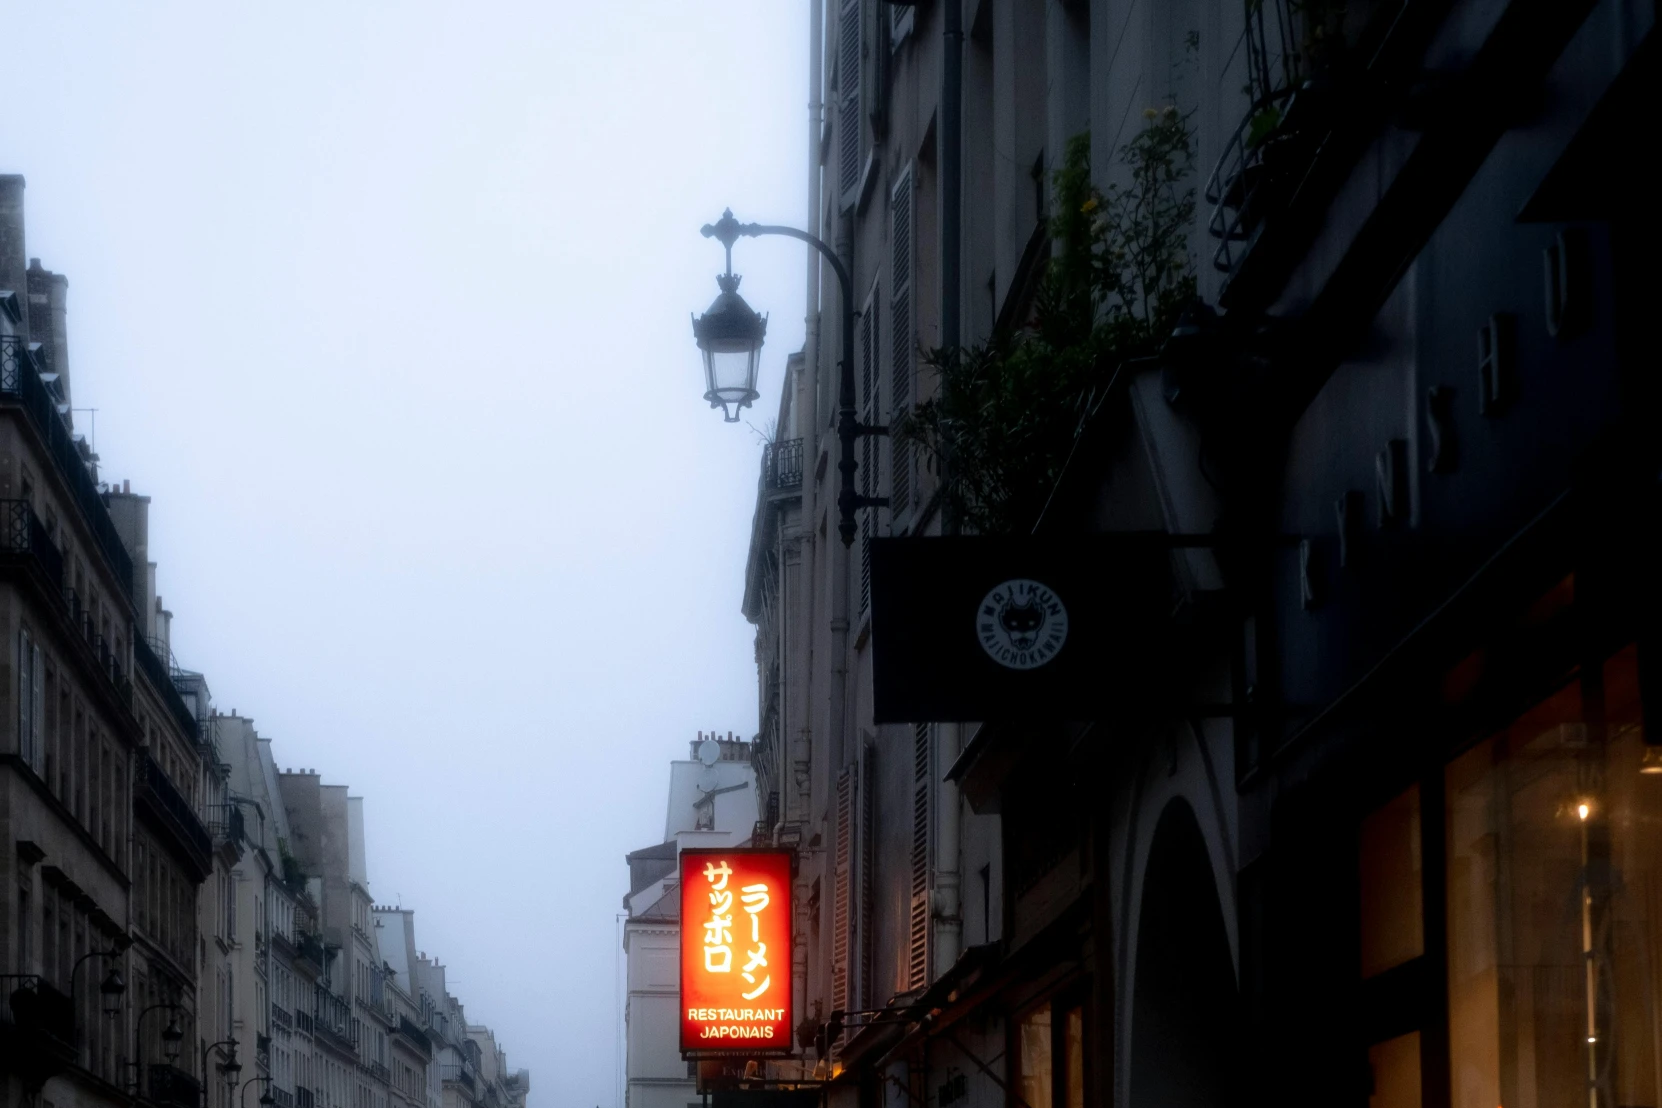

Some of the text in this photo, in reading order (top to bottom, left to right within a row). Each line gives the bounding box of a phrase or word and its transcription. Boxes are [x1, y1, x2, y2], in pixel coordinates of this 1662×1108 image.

[702, 860, 733, 973] サッポロ
[740, 883, 770, 1000] ラーメン
[688, 1008, 785, 1022] RESTAURANT
[700, 1026, 774, 1039] JAPONAIS
